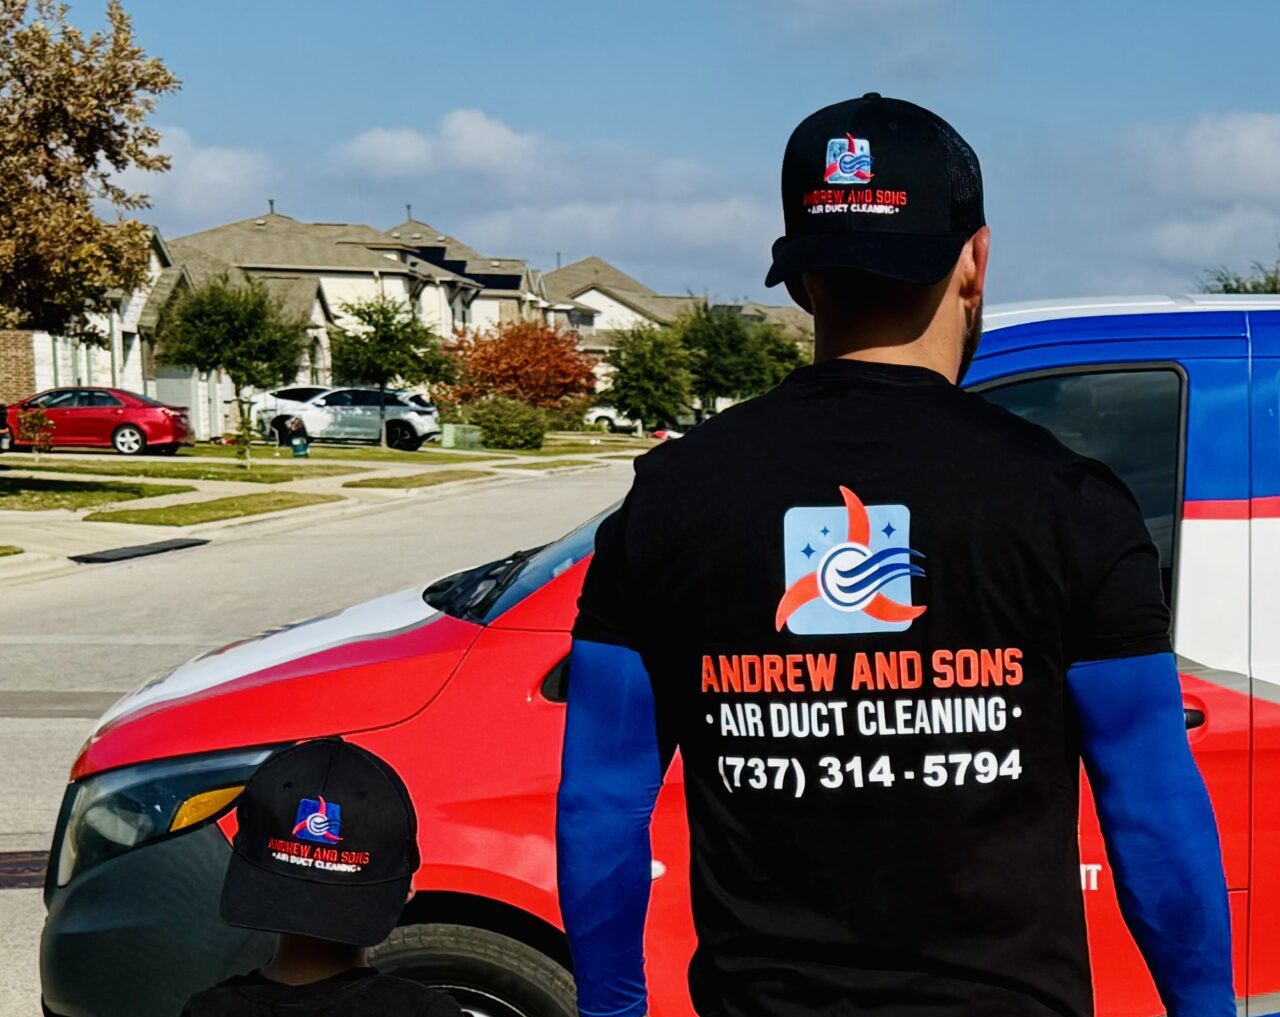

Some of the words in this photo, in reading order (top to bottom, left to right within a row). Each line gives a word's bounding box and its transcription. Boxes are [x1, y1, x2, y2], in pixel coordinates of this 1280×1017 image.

[848, 189, 872, 205] AND
[876, 190, 907, 205] SONS
[811, 204, 824, 214] AIR
[825, 204, 849, 213] DUCT
[850, 204, 895, 214] CLEANING
[702, 654, 837, 692] ANDREW
[851, 651, 922, 690] AND
[932, 648, 1023, 688] SONS
[720, 703, 764, 737] AIR
[770, 701, 848, 738] DUCT
[857, 697, 1006, 736] CLEANING
[718, 756, 806, 798] (737)
[275, 852, 289, 862] AIR
[290, 855, 313, 867] DUCT
[314, 847, 338, 862] AND
